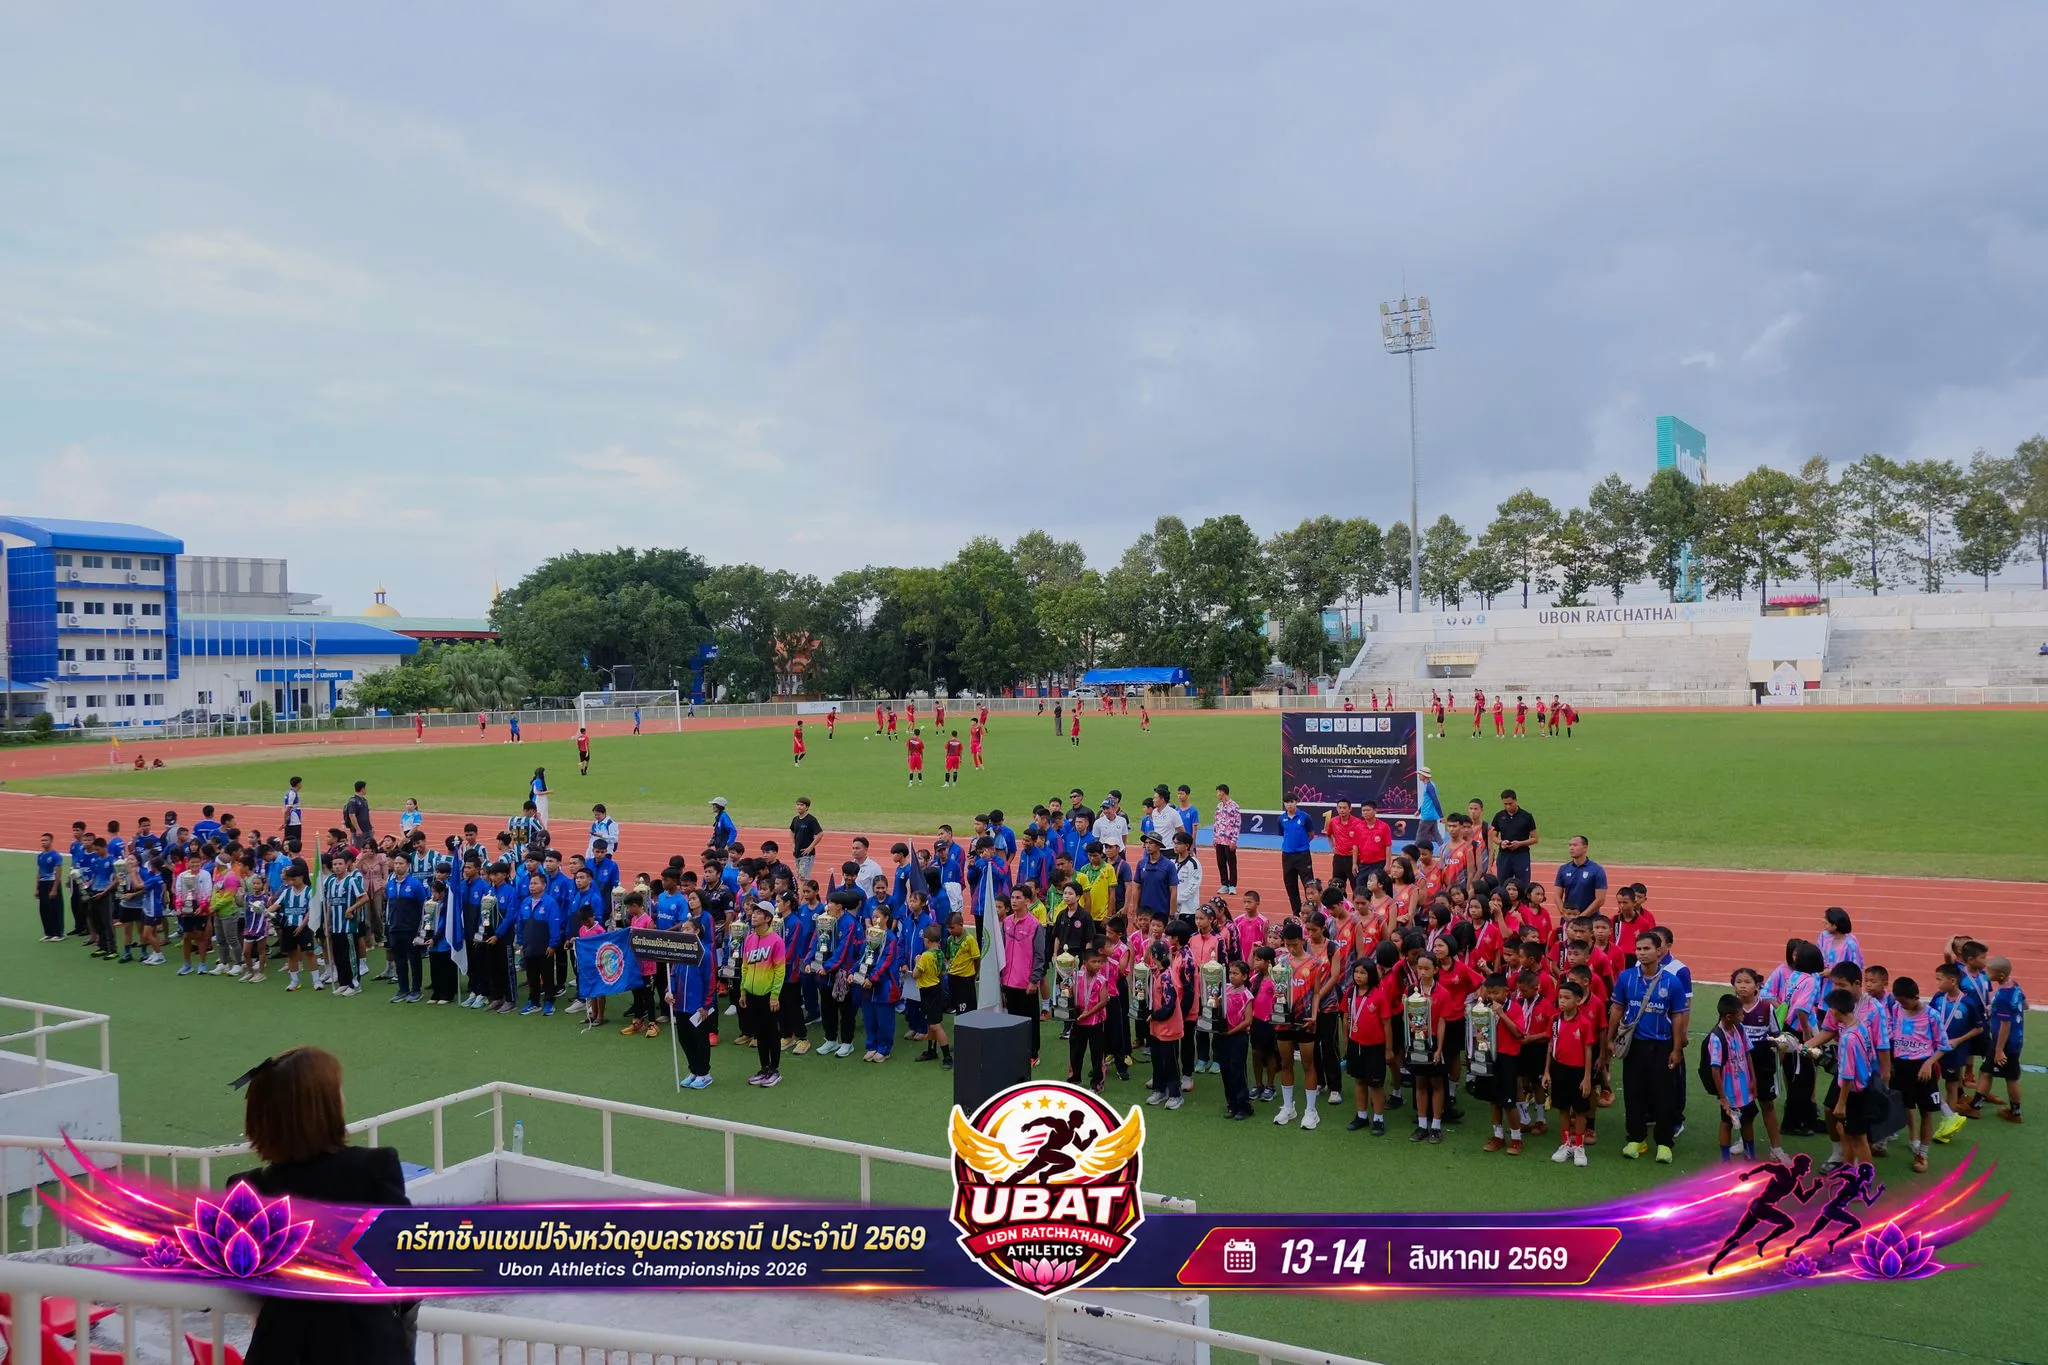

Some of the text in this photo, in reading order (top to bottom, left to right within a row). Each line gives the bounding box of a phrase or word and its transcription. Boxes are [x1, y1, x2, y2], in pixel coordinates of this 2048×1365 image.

[1539, 607, 1677, 624] UBON RATCHATHA
[1250, 815, 1264, 832] 2
[1322, 810, 1333, 834] 1
[1395, 820, 1407, 837] 3
